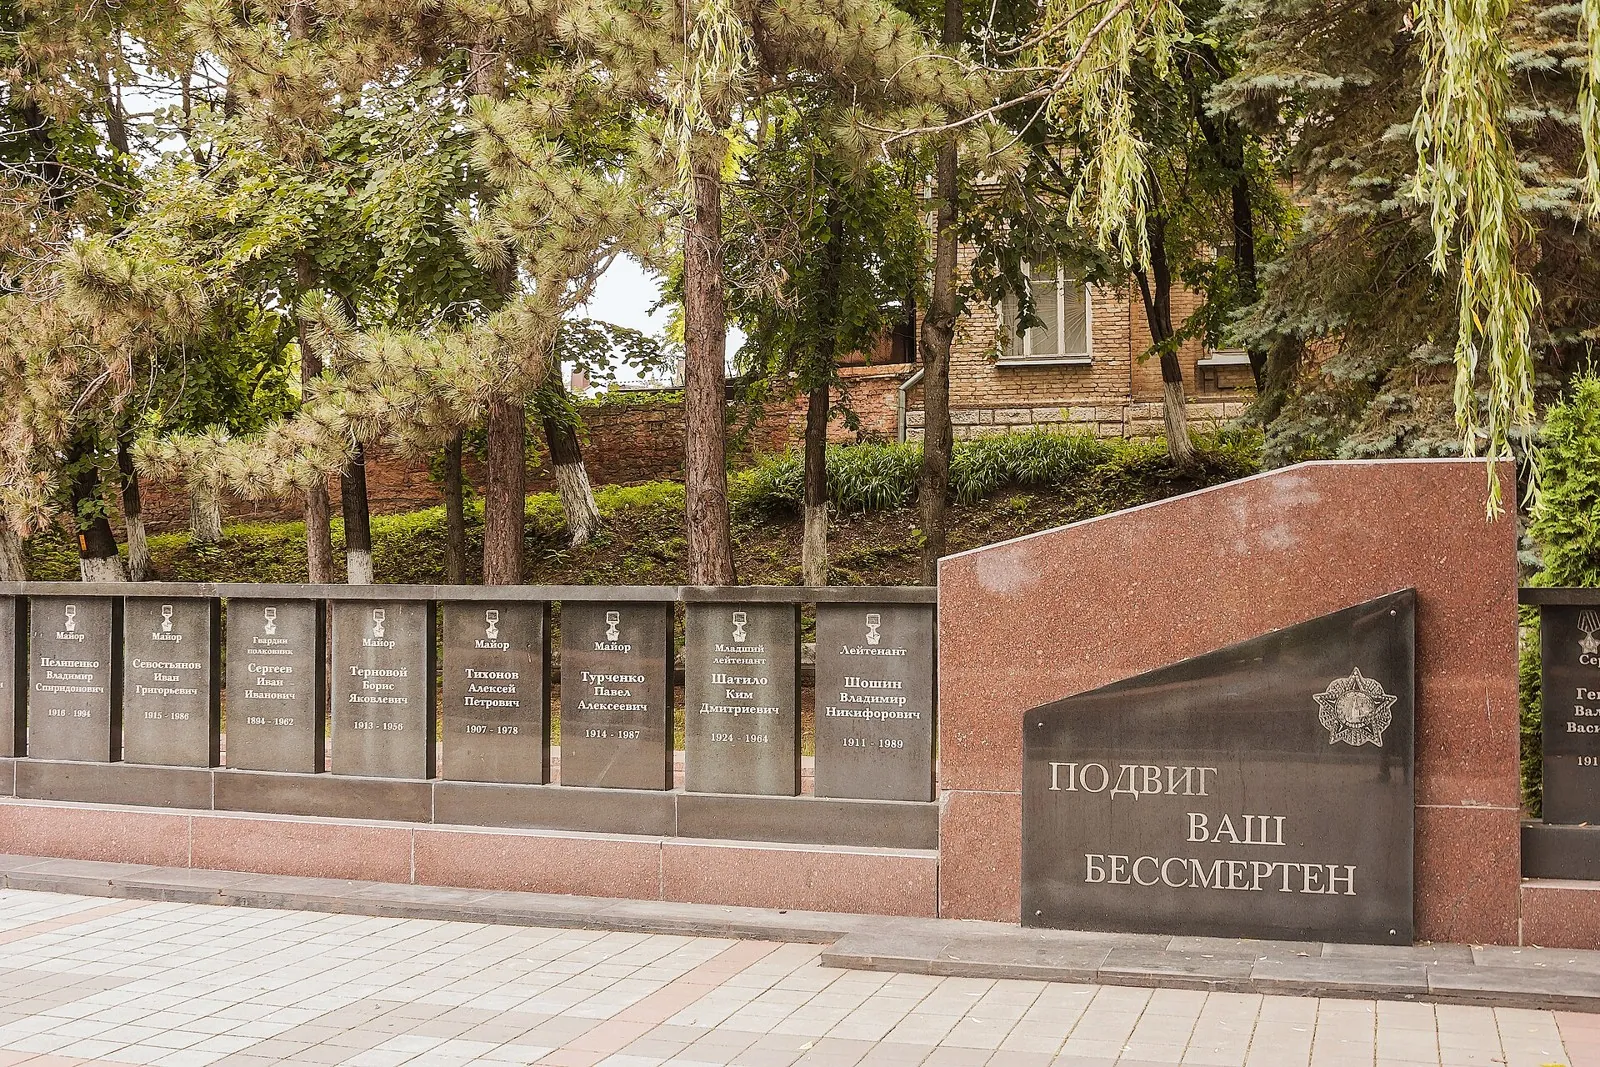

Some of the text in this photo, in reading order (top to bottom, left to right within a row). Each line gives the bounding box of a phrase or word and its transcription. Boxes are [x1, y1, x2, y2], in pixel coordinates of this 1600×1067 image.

[56, 631, 85, 642] Майор
[152, 632, 182, 643] Майор
[253, 637, 288, 646] Гвардии
[362, 639, 396, 650] Майор
[475, 640, 510, 651] Майор
[595, 642, 631, 653] Майор
[715, 644, 765, 654] Младший
[840, 645, 907, 656] Лейтенант
[40, 658, 99, 668] Пелипенко
[132, 659, 201, 669] Севостьянов
[712, 657, 766, 665] лейтенант
[247, 663, 293, 674] Сергеев
[350, 666, 408, 678] Терновой
[46, 671, 93, 682] Владимир
[153, 673, 179, 682] Иван
[465, 669, 519, 680] Тихонов
[581, 672, 645, 684] Турченко
[711, 674, 768, 685] Шатило
[257, 678, 283, 686] Иван
[362, 682, 395, 691] Борис
[844, 677, 902, 689] Шошин
[36, 683, 104, 694] Спиридонович
[136, 685, 197, 696] Григорьевич
[468, 683, 516, 694] Алексей
[594, 687, 631, 697] Павел
[244, 691, 295, 700] Иванович
[349, 694, 408, 704] Яковлевич
[726, 690, 753, 699] Ким
[840, 693, 907, 706] Владимир
[464, 697, 520, 709] Петрович
[578, 700, 647, 711] Алексеевич
[144, 711, 162, 719] 1915
[170, 712, 189, 720] 1986
[700, 704, 779, 716] Дмитриевич
[826, 707, 920, 721] Никифорович
[247, 717, 265, 725] 1894
[275, 718, 294, 726] 1962
[354, 722, 373, 730] 1913
[383, 723, 403, 731] 1956
[466, 726, 487, 734] 1907
[497, 726, 519, 734] 1978
[585, 730, 607, 738] 1914
[618, 731, 640, 739] 1987
[711, 733, 733, 742] 1924
[745, 735, 768, 743] 1964
[842, 738, 866, 747] 1911
[878, 739, 903, 748] 1989
[1048, 762, 1218, 800] ПОДВИГ
[1187, 813, 1286, 846] ВАШ
[1084, 854, 1357, 896] БЕССМЕРТЕН
